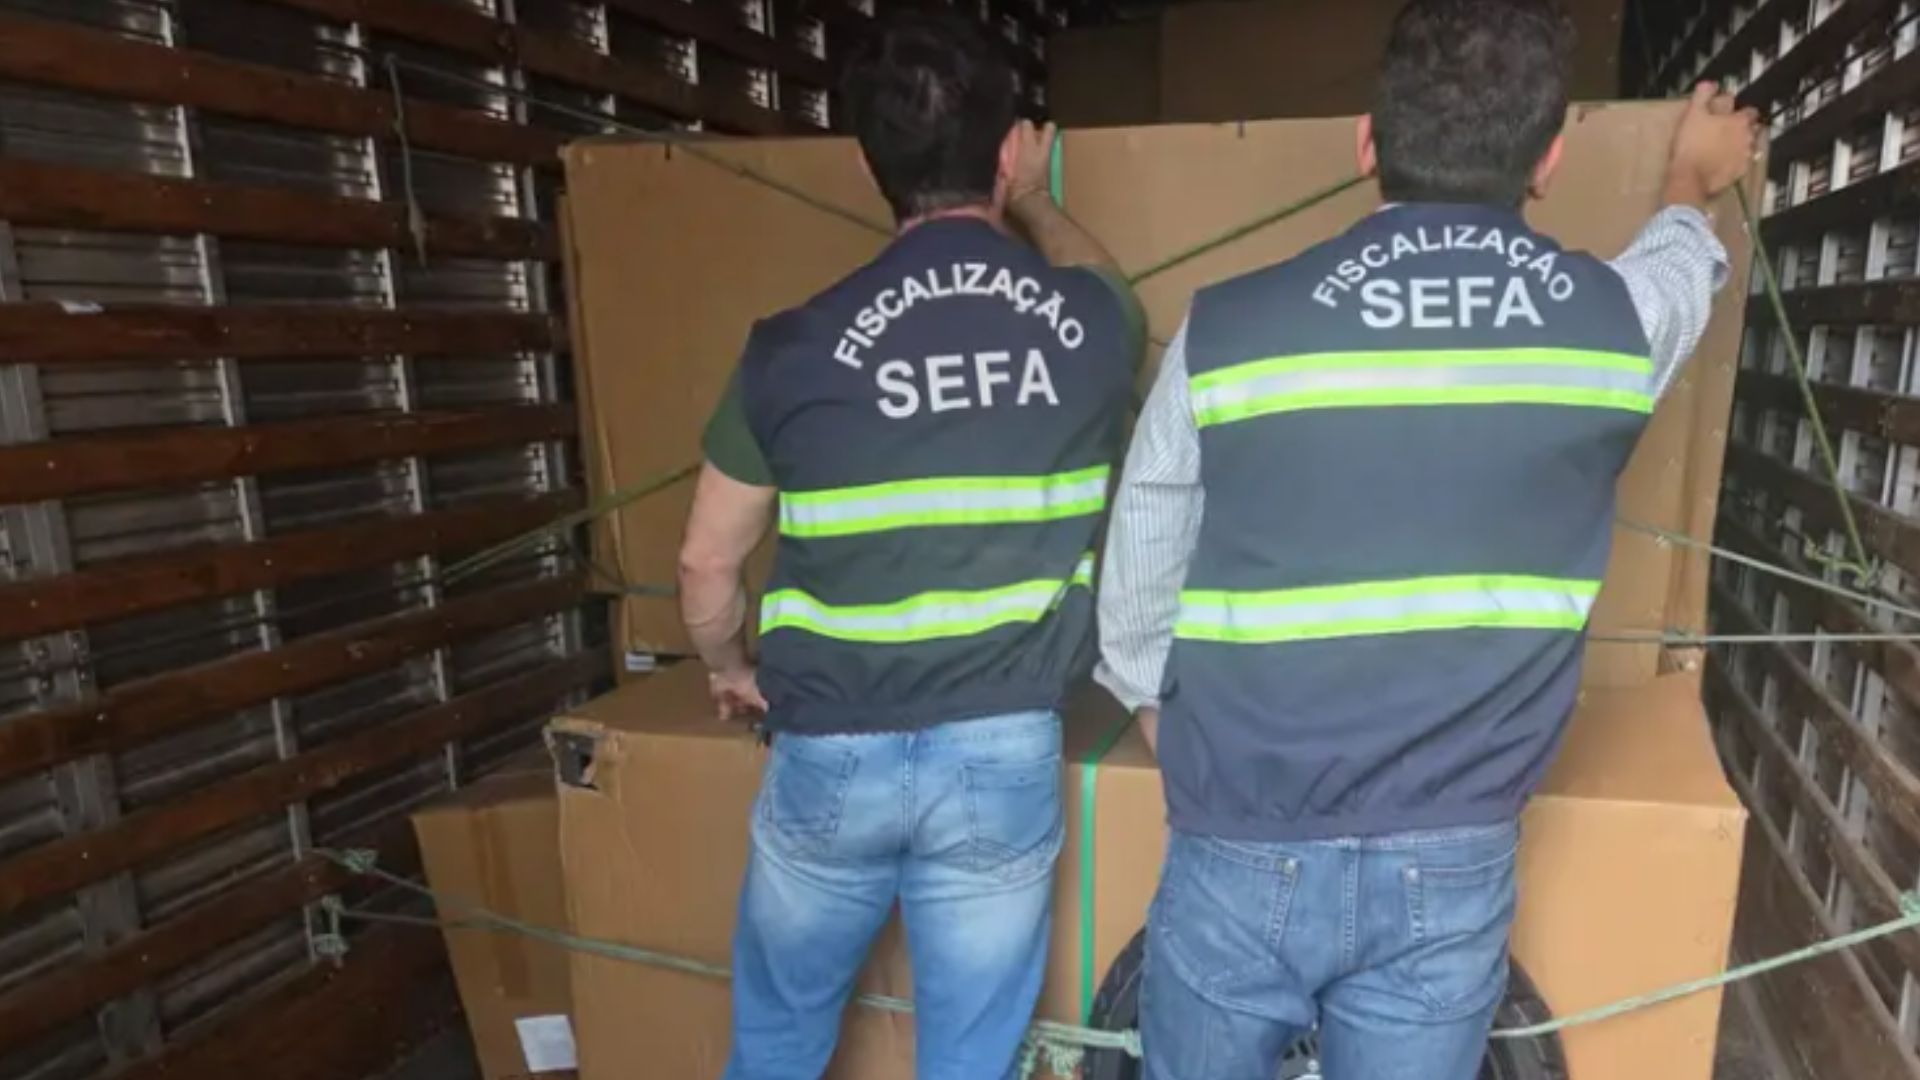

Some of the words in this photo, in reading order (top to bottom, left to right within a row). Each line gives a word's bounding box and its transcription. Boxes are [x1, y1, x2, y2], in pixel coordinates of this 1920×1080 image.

[1312, 225, 1575, 308] FISCALIZAÇÃO
[1360, 276, 1544, 328] SEFA
[833, 262, 1085, 370] FISCALIZAÇÃO
[875, 349, 1060, 419] SEFA
